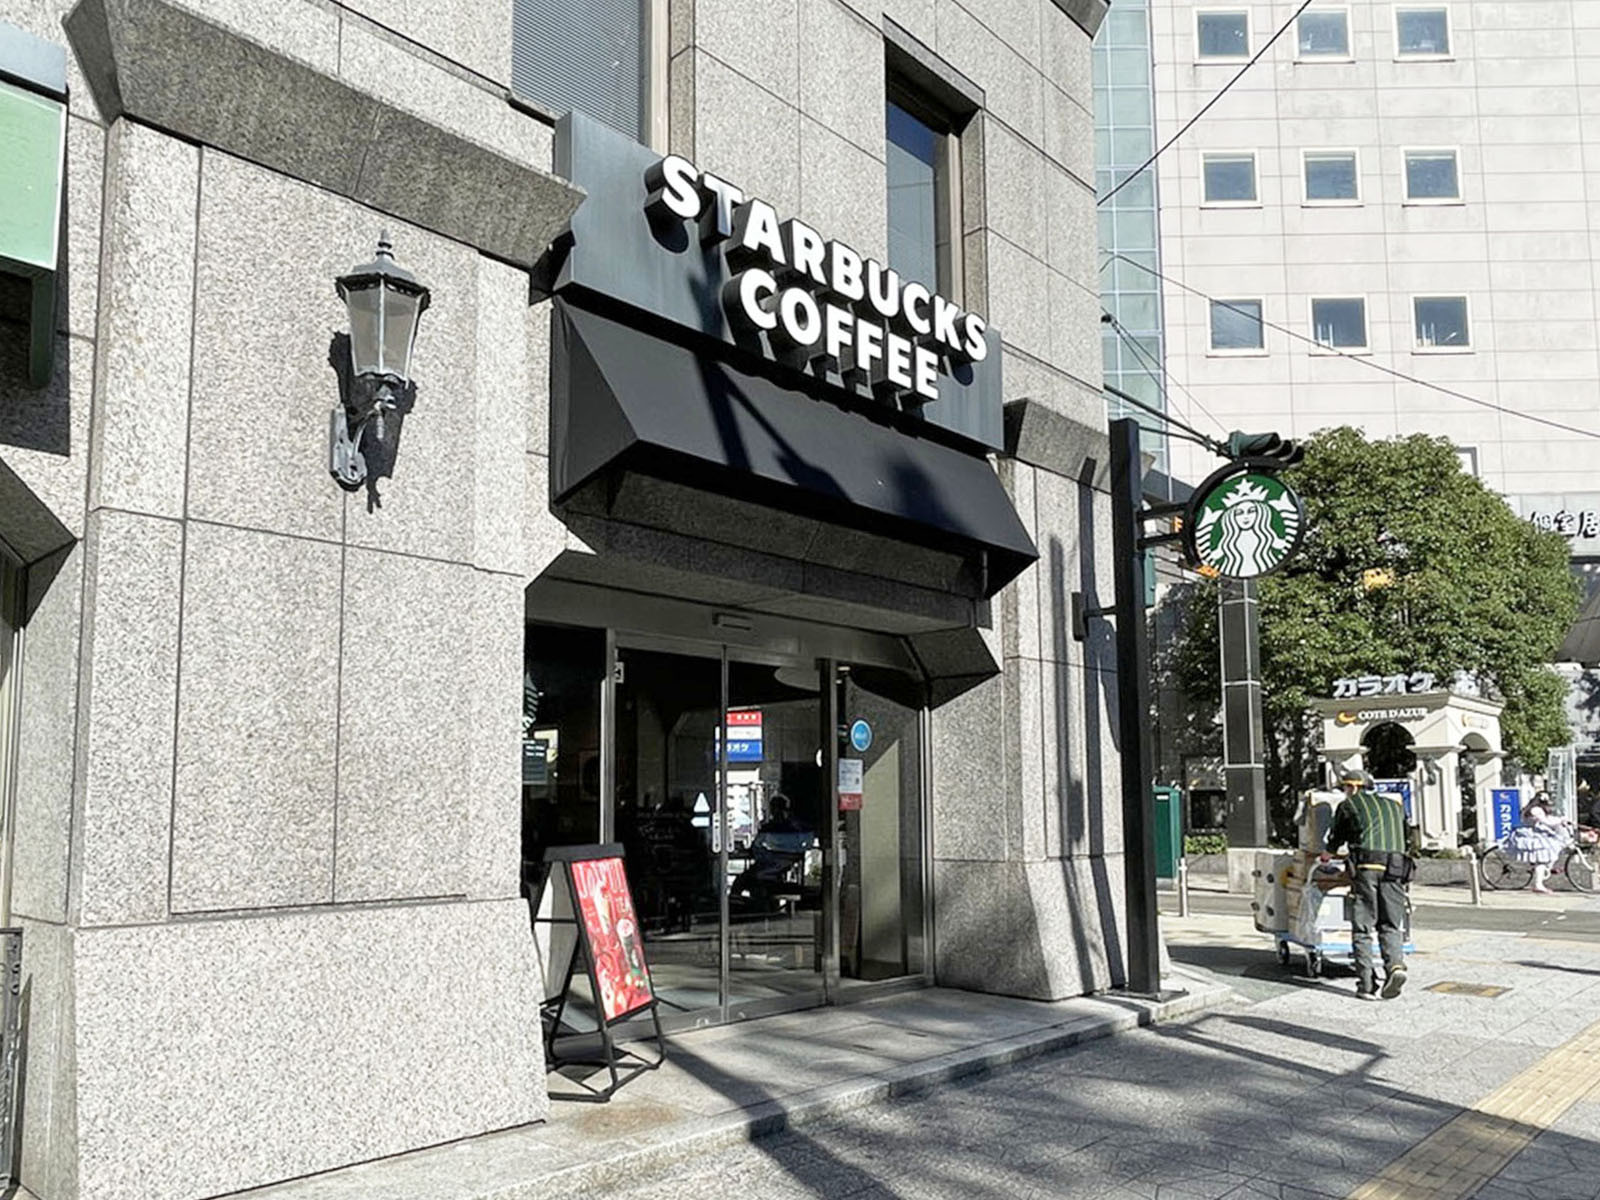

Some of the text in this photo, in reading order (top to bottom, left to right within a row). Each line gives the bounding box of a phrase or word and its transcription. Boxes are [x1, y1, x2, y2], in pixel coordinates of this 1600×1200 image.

[661, 153, 989, 363] STARBUCKS
[739, 267, 940, 401] COFFEE
[1332, 671, 1436, 698] カラオケ
